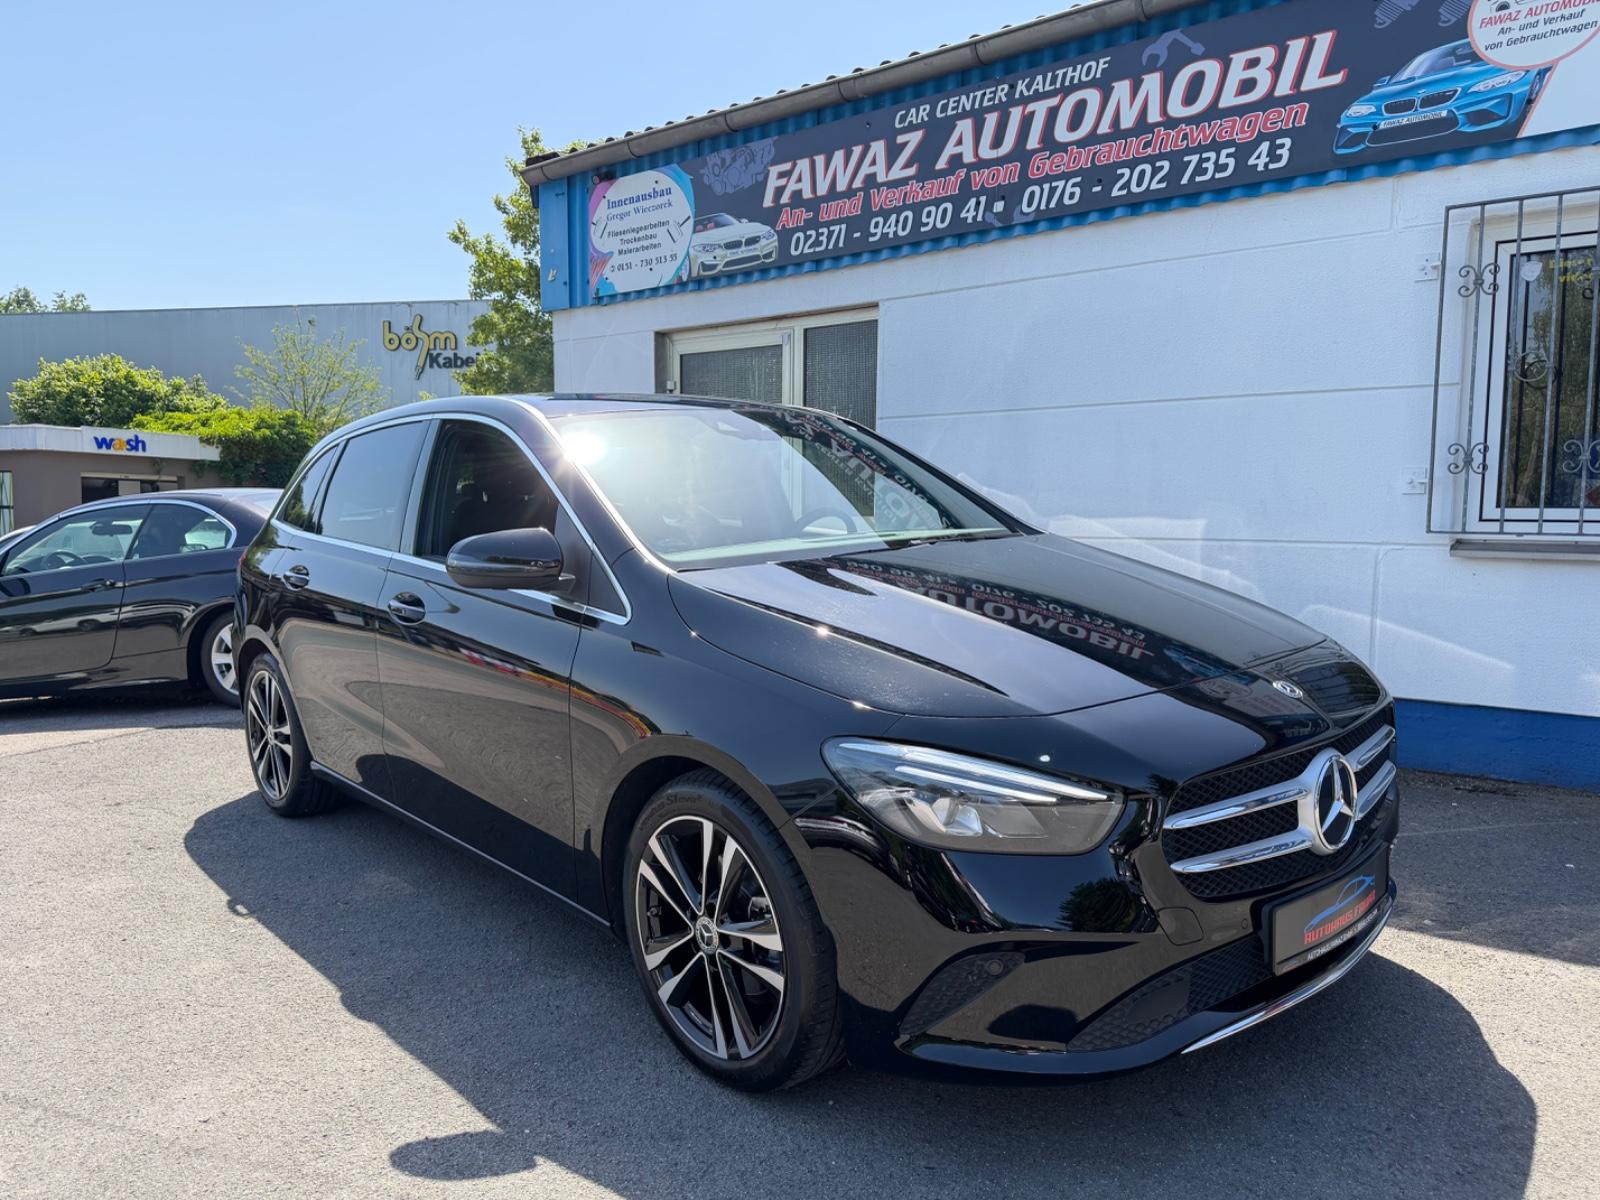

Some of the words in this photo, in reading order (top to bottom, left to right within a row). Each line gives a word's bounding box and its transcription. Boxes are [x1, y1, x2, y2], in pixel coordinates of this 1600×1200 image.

[1479, 10, 1521, 29] FAWAZ
[1524, 0, 1600, 19] AUTOMO
[1497, 26, 1515, 36] An-
[1518, 20, 1539, 31] und
[1543, 8, 1586, 26] Verkauf
[1484, 41, 1503, 51] von
[1506, 20, 1598, 47] Gebrauchtwagen
[894, 104, 929, 129] CAR
[935, 83, 1009, 119] CENTER
[1014, 56, 1111, 100] KALTHOF
[762, 128, 926, 209] FAWAZ
[934, 29, 1348, 171] AUTOMOBIL
[776, 207, 813, 230] An-
[819, 193, 863, 222] und
[870, 168, 967, 210] Verkauf
[971, 161, 1020, 190] von
[1028, 102, 1310, 179] Gebrauchtwagen
[1021, 176, 1082, 214] 0176
[1110, 159, 1171, 198] 202
[1180, 147, 1236, 184] 735
[1248, 137, 1292, 172] 43
[606, 187, 672, 210] Innenausbau
[606, 211, 631, 222] Gregor
[633, 199, 673, 214] Wieczorek
[607, 220, 670, 239] Fliesenlegearbeiten
[620, 232, 657, 246] Trockenbau
[790, 223, 847, 256] 02371
[869, 210, 914, 242] 940
[920, 202, 954, 232] 90
[960, 195, 986, 223] 41
[617, 241, 662, 257] Malerarbeiten
[640, 257, 653, 268] 730
[428, 352, 481, 369] Kabe
[93, 434, 147, 453] wash
[1304, 909, 1353, 944] AUTOHAUS
